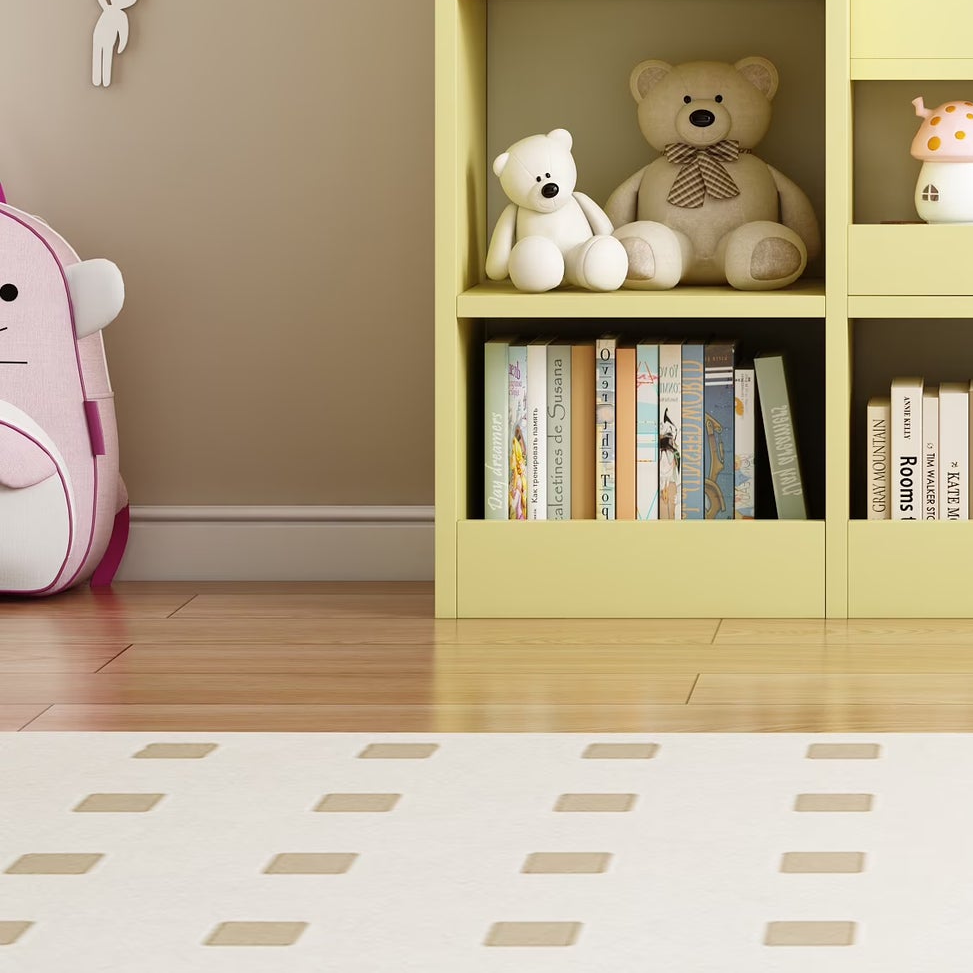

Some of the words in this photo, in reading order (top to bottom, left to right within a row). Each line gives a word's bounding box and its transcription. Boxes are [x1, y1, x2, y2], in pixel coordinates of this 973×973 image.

[547, 358, 566, 421] Susana
[903, 396, 911, 417] ANNIE
[484, 412, 503, 476] dreamers
[547, 424, 563, 444] de
[903, 418, 911, 440] KELLY
[872, 419, 886, 482] MOUNTAIN
[926, 453, 935, 468] TIM
[487, 480, 506, 511] Day
[872, 484, 886, 513] GRAY
[900, 456, 918, 512] Rooms
[926, 470, 935, 505] WALKER
[947, 471, 960, 504] KATE
[947, 507, 960, 520] M
